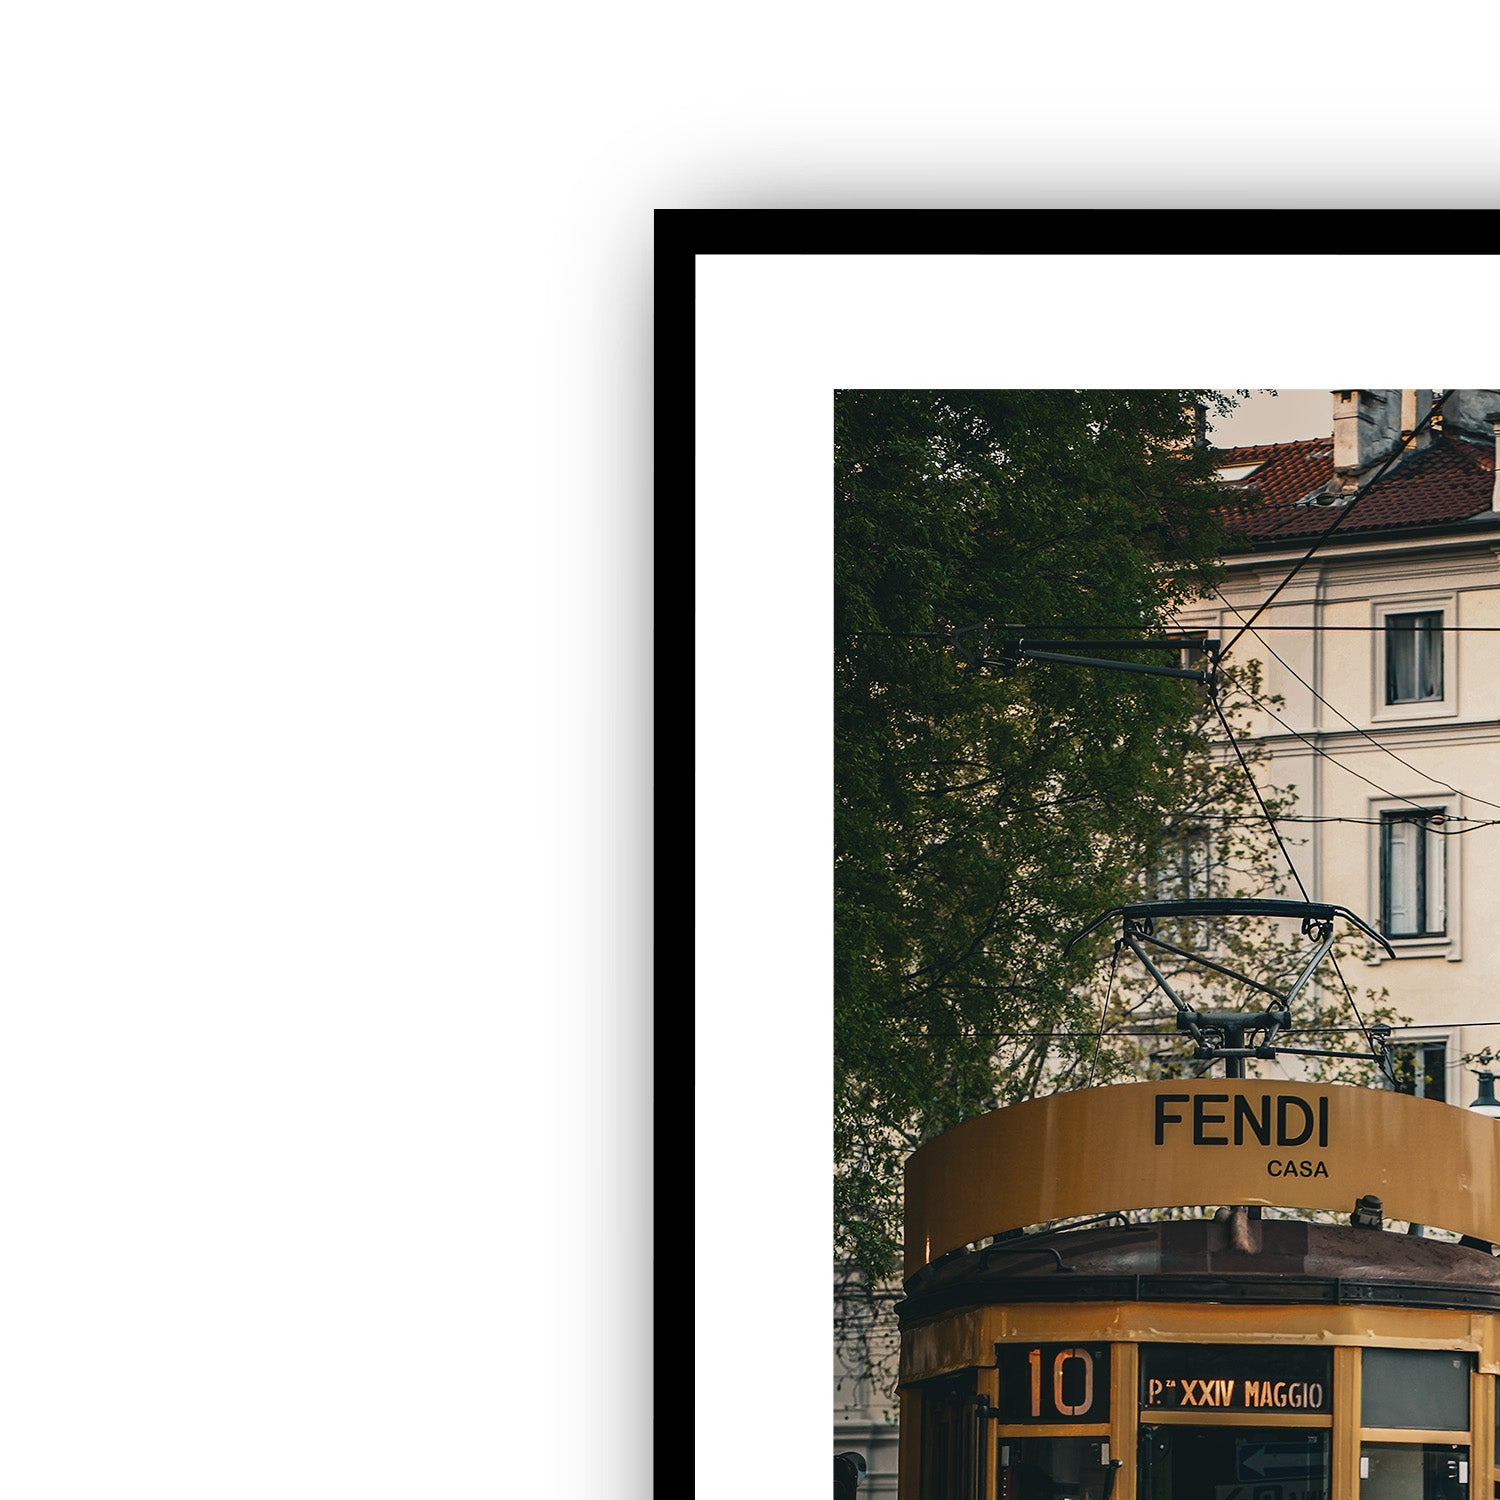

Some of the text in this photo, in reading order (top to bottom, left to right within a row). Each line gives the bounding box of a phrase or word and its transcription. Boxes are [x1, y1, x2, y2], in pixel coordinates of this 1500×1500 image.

[1154, 1094, 1329, 1148] FENDI
[1267, 1159, 1329, 1178] CASA
[1028, 1348, 1093, 1417] 10
[1180, 1379, 1235, 1407] XXIV
[1244, 1380, 1323, 1408] MAGGIO
